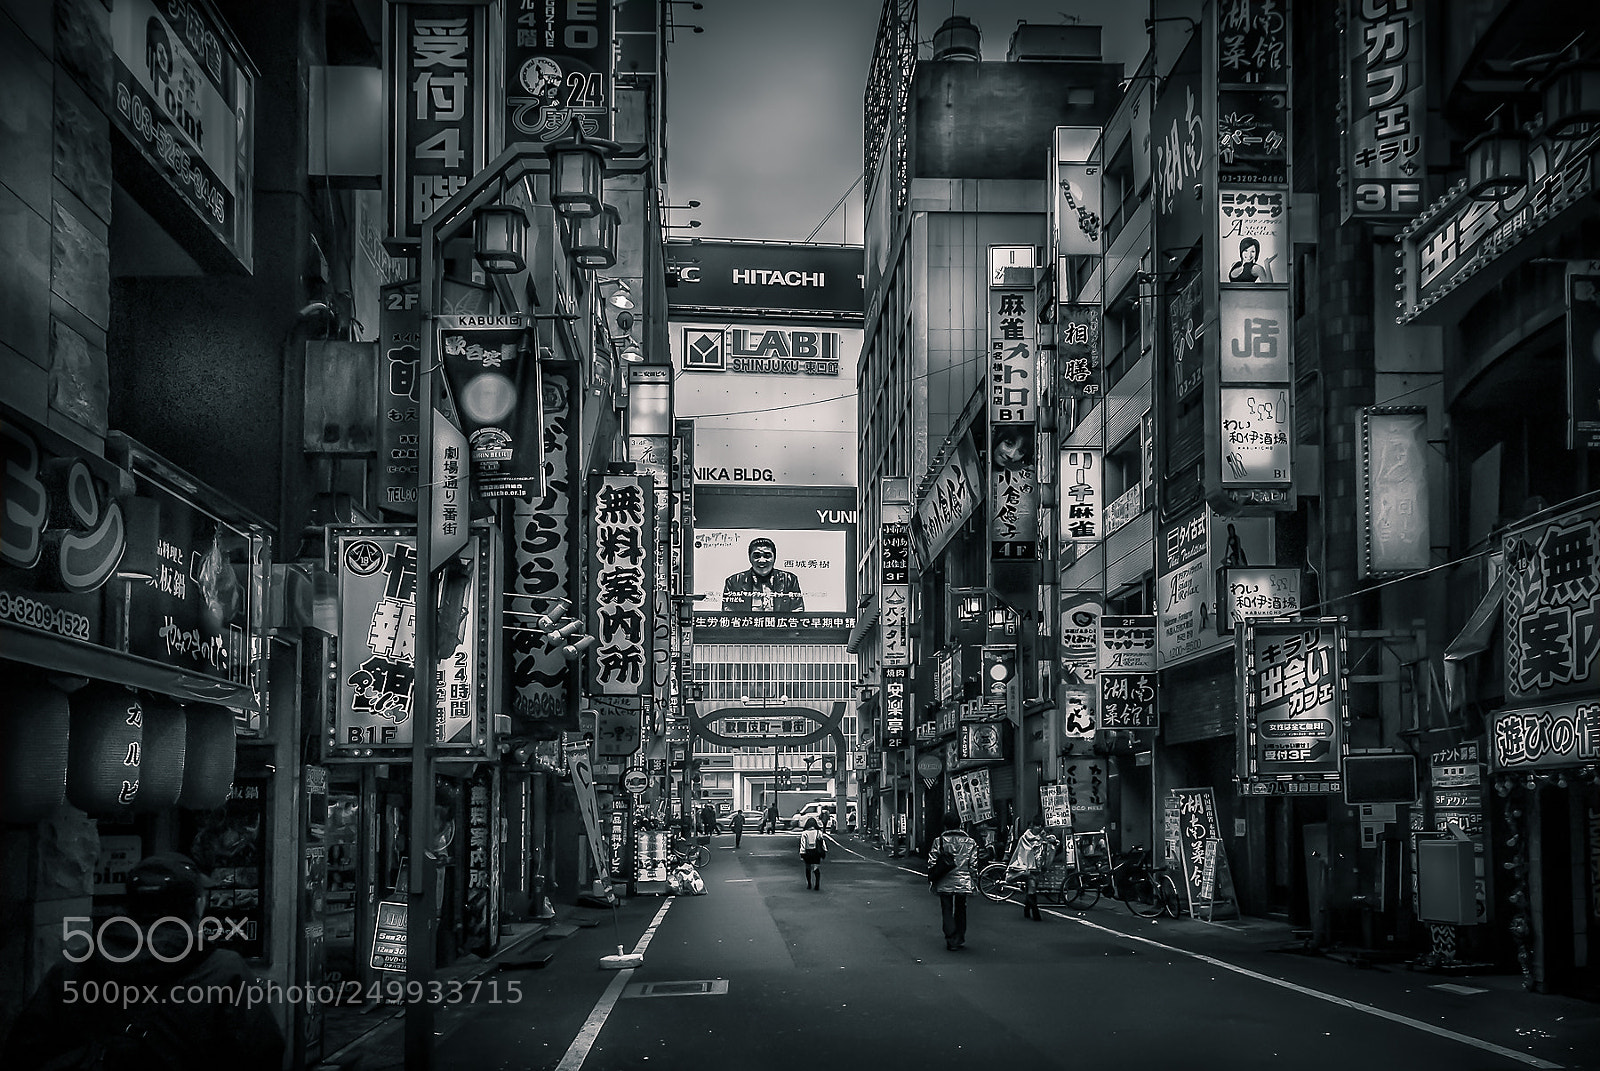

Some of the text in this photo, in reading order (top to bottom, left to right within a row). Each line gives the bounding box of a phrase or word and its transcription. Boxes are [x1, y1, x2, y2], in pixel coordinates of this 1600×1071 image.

[567, 72, 604, 107] 24
[1355, 137, 1420, 168] キラリ
[1356, 184, 1420, 212] 3F
[732, 268, 825, 288] HITACHI
[388, 294, 418, 310] 2F
[998, 294, 1026, 340] 麻雀
[732, 328, 839, 359] LABI
[733, 359, 800, 373] SHINJUKU
[1083, 384, 1099, 395] 4F
[1000, 409, 1025, 421] B1
[1222, 419, 1252, 430] わい
[733, 469, 776, 482] BLDG.
[1273, 469, 1287, 479] B1
[441, 446, 461, 538] 劇場通り一番街
[999, 543, 1026, 557] 4F
[597, 482, 646, 685] 無料案内所
[886, 572, 905, 580] 3F
[1230, 582, 1259, 595] わい
[1261, 627, 1322, 664] キラリ
[450, 652, 470, 719] 24時間
[1259, 648, 1331, 706] 出会い
[1103, 675, 1155, 703] 湖南
[887, 682, 905, 734] 安楽亭
[1287, 682, 1335, 719] カフェ
[1103, 704, 1141, 726] 菜館
[347, 727, 398, 744] B1F
[725, 720, 804, 733] 歌舞伎町一番街
[117, 701, 142, 804] カルビ
[888, 738, 902, 747] 2F
